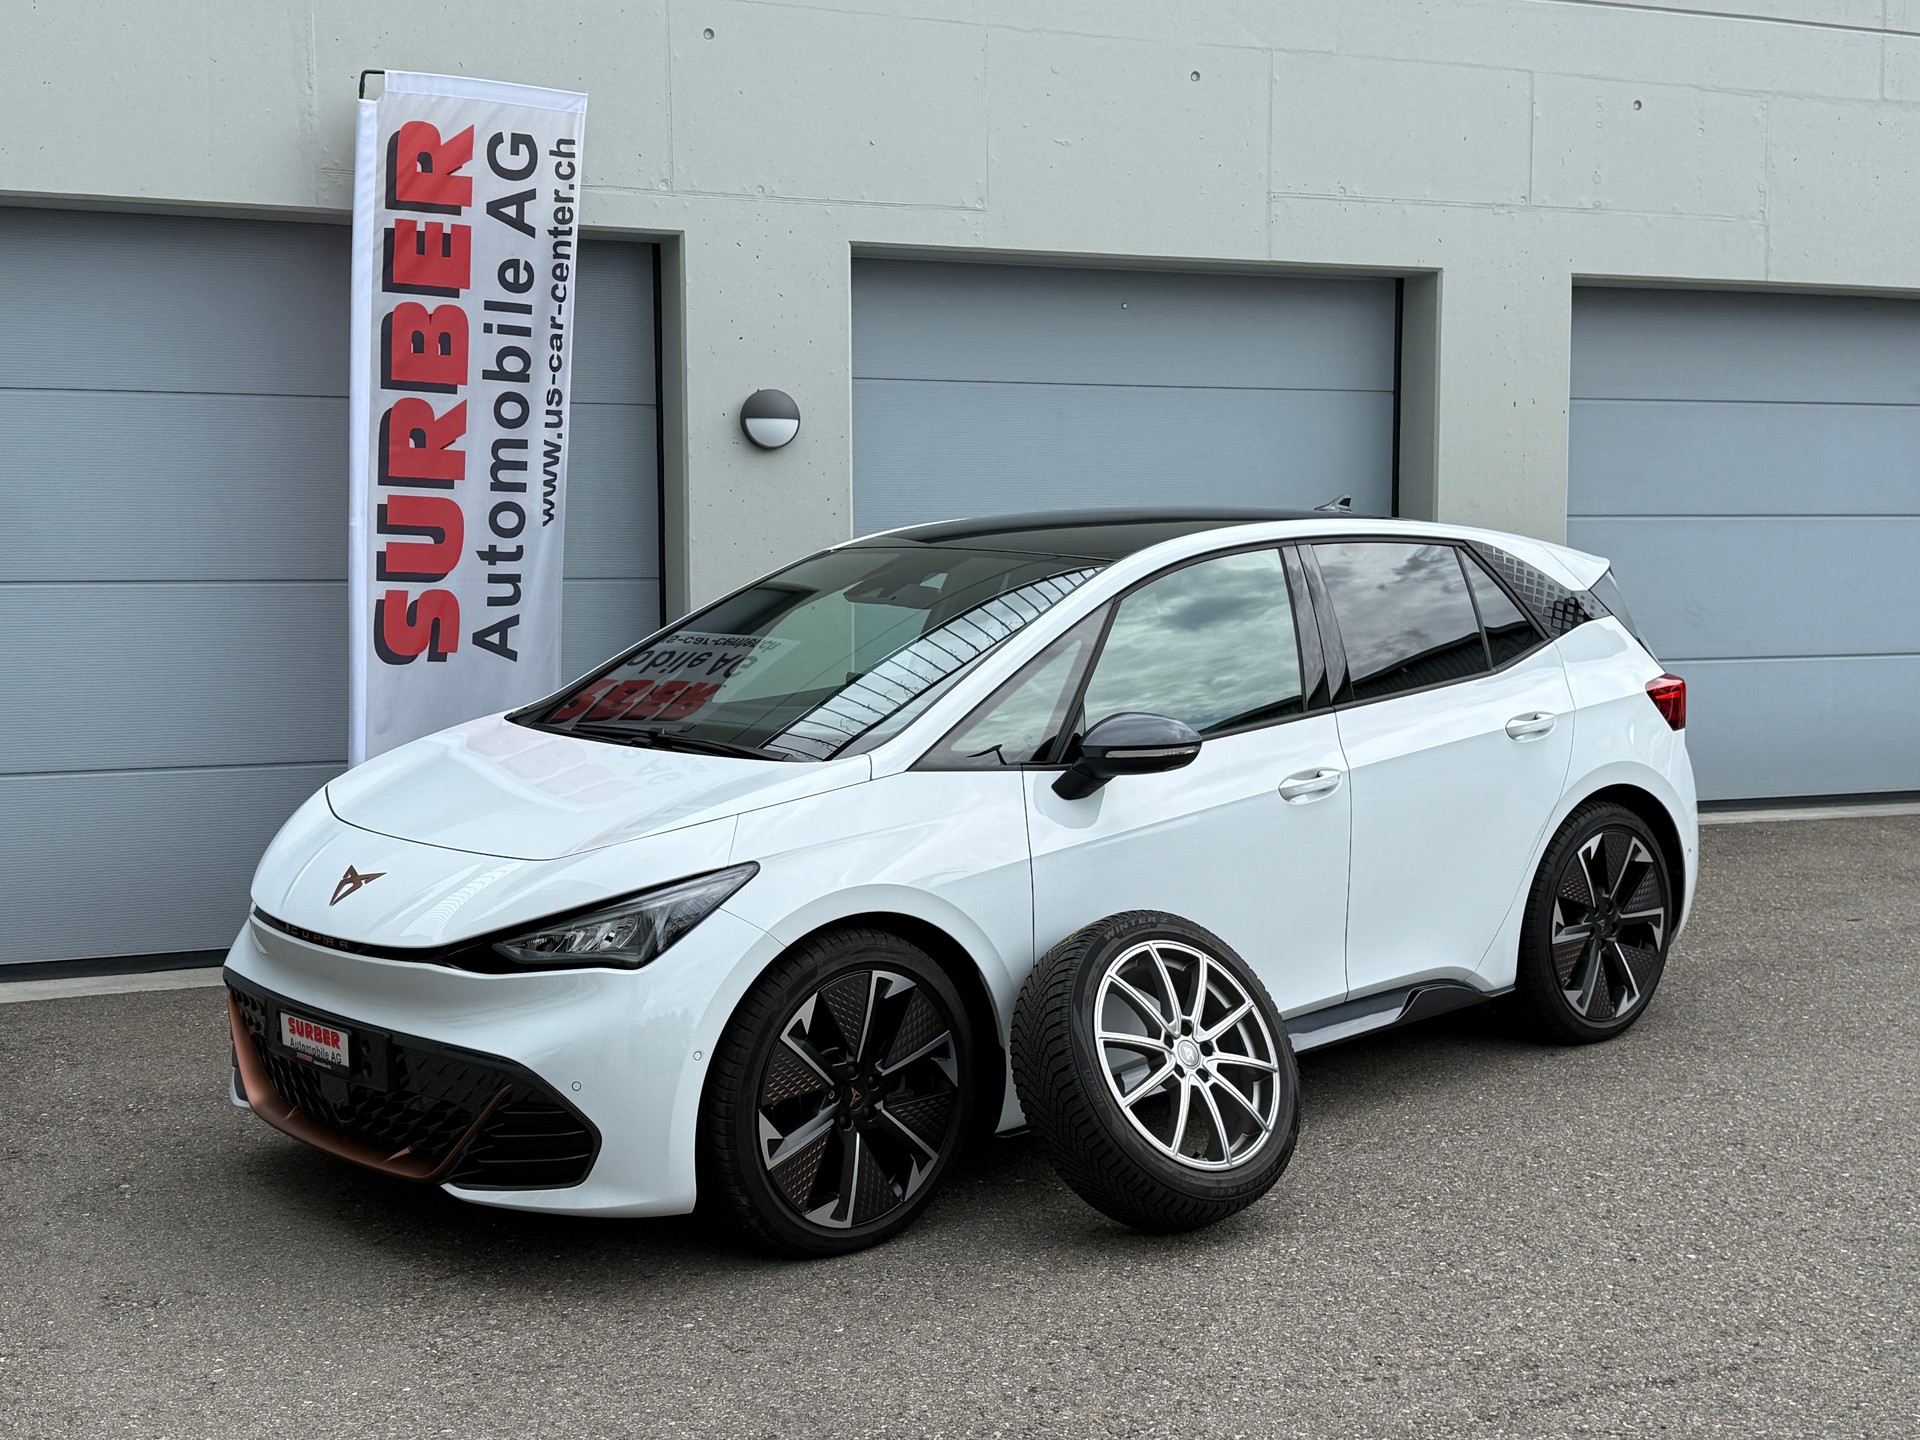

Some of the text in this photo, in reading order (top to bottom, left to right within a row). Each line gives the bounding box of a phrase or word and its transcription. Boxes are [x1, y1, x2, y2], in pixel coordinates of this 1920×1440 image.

[373, 120, 475, 665] SURBER
[471, 131, 538, 663] Automobile AG
[542, 137, 576, 527] www.us-car-center.ch
[288, 1016, 341, 1050] SURBER
[290, 1037, 330, 1061] Automobile
[330, 1050, 342, 1064] AG
